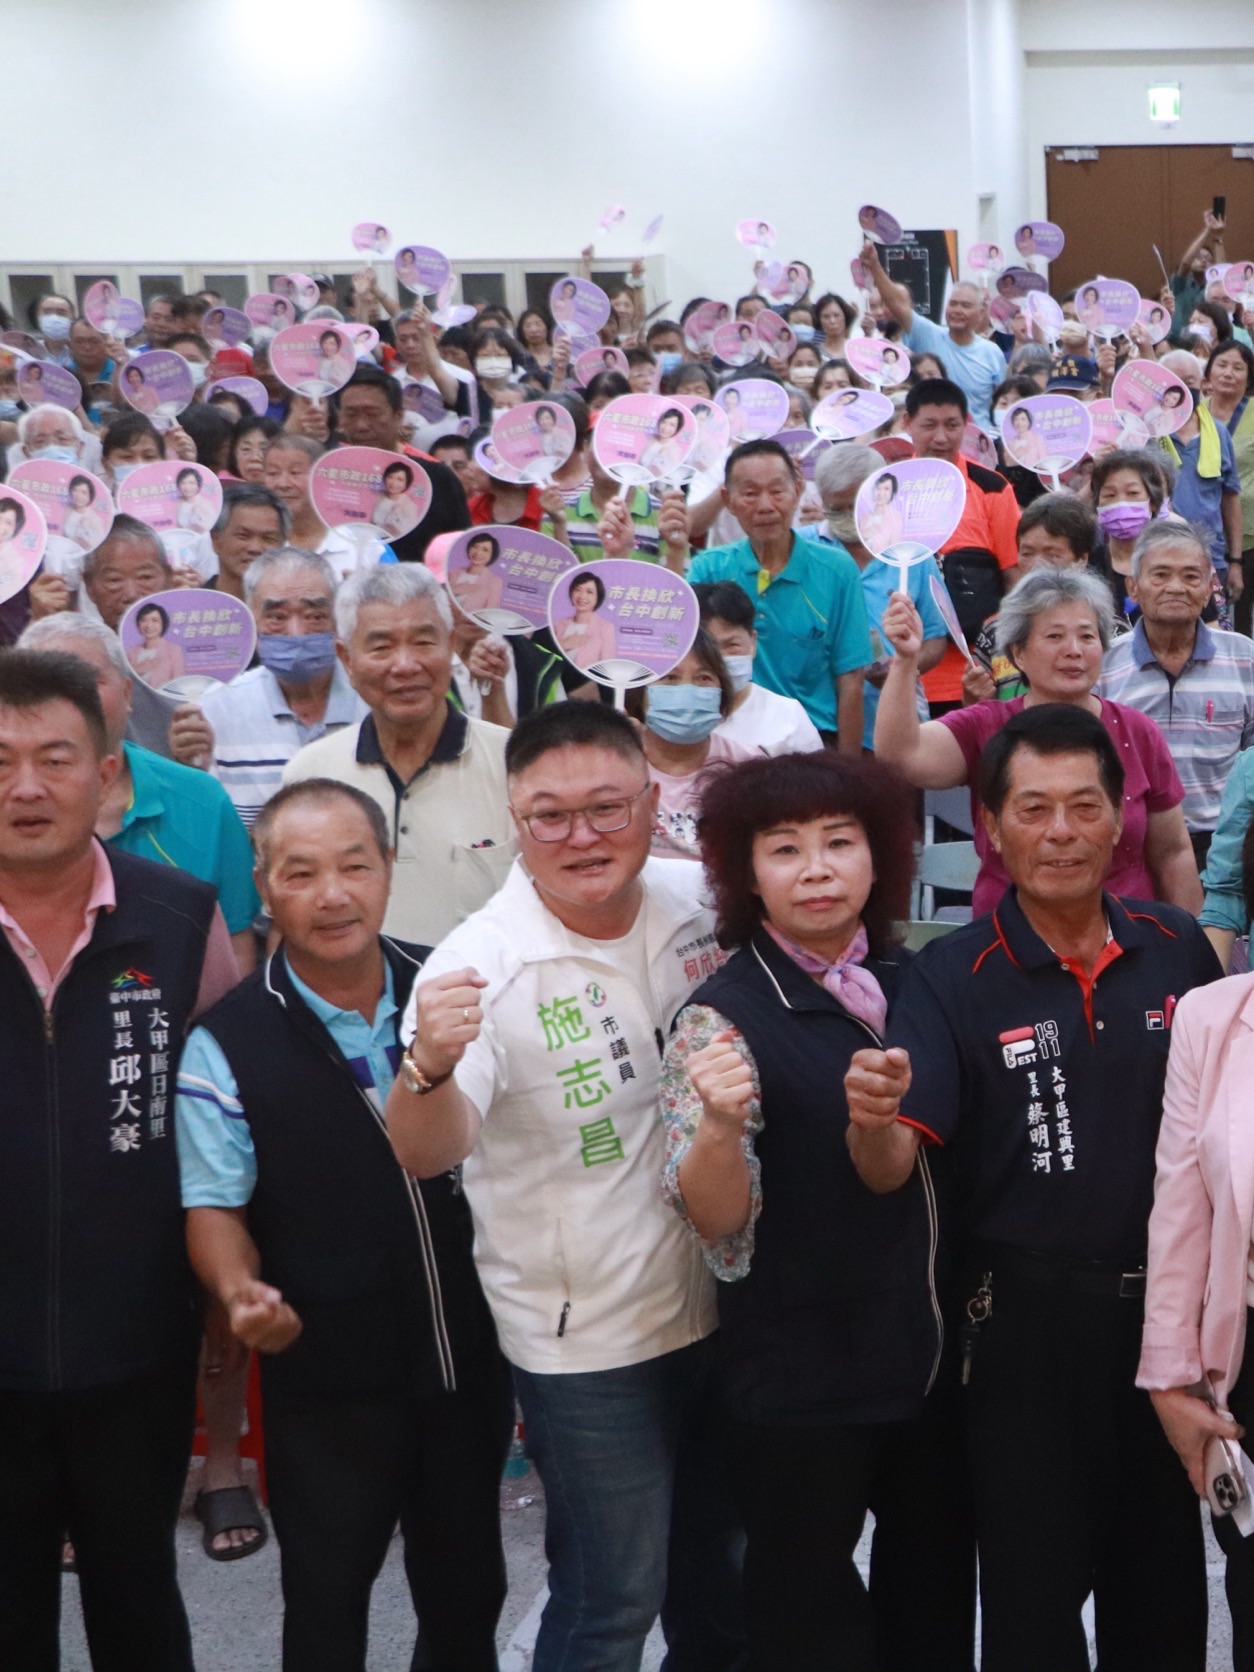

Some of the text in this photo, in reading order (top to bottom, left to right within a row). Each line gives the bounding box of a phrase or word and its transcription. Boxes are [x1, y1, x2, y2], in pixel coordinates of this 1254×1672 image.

[503, 548, 563, 571] 市長換欣
[508, 564, 561, 583] 台中創
[608, 586, 677, 604] 市長換欣
[173, 608, 232, 624] 市長換欣
[617, 602, 685, 622] 台中創新
[183, 622, 243, 639] 台中創新
[600, 1015, 636, 1084] 市議員
[1017, 1052, 1037, 1066] EST
[148, 1007, 170, 1140] 大甲區日南里
[537, 995, 625, 1167] 施志昌
[1052, 1066, 1075, 1171] 大甲區建興里
